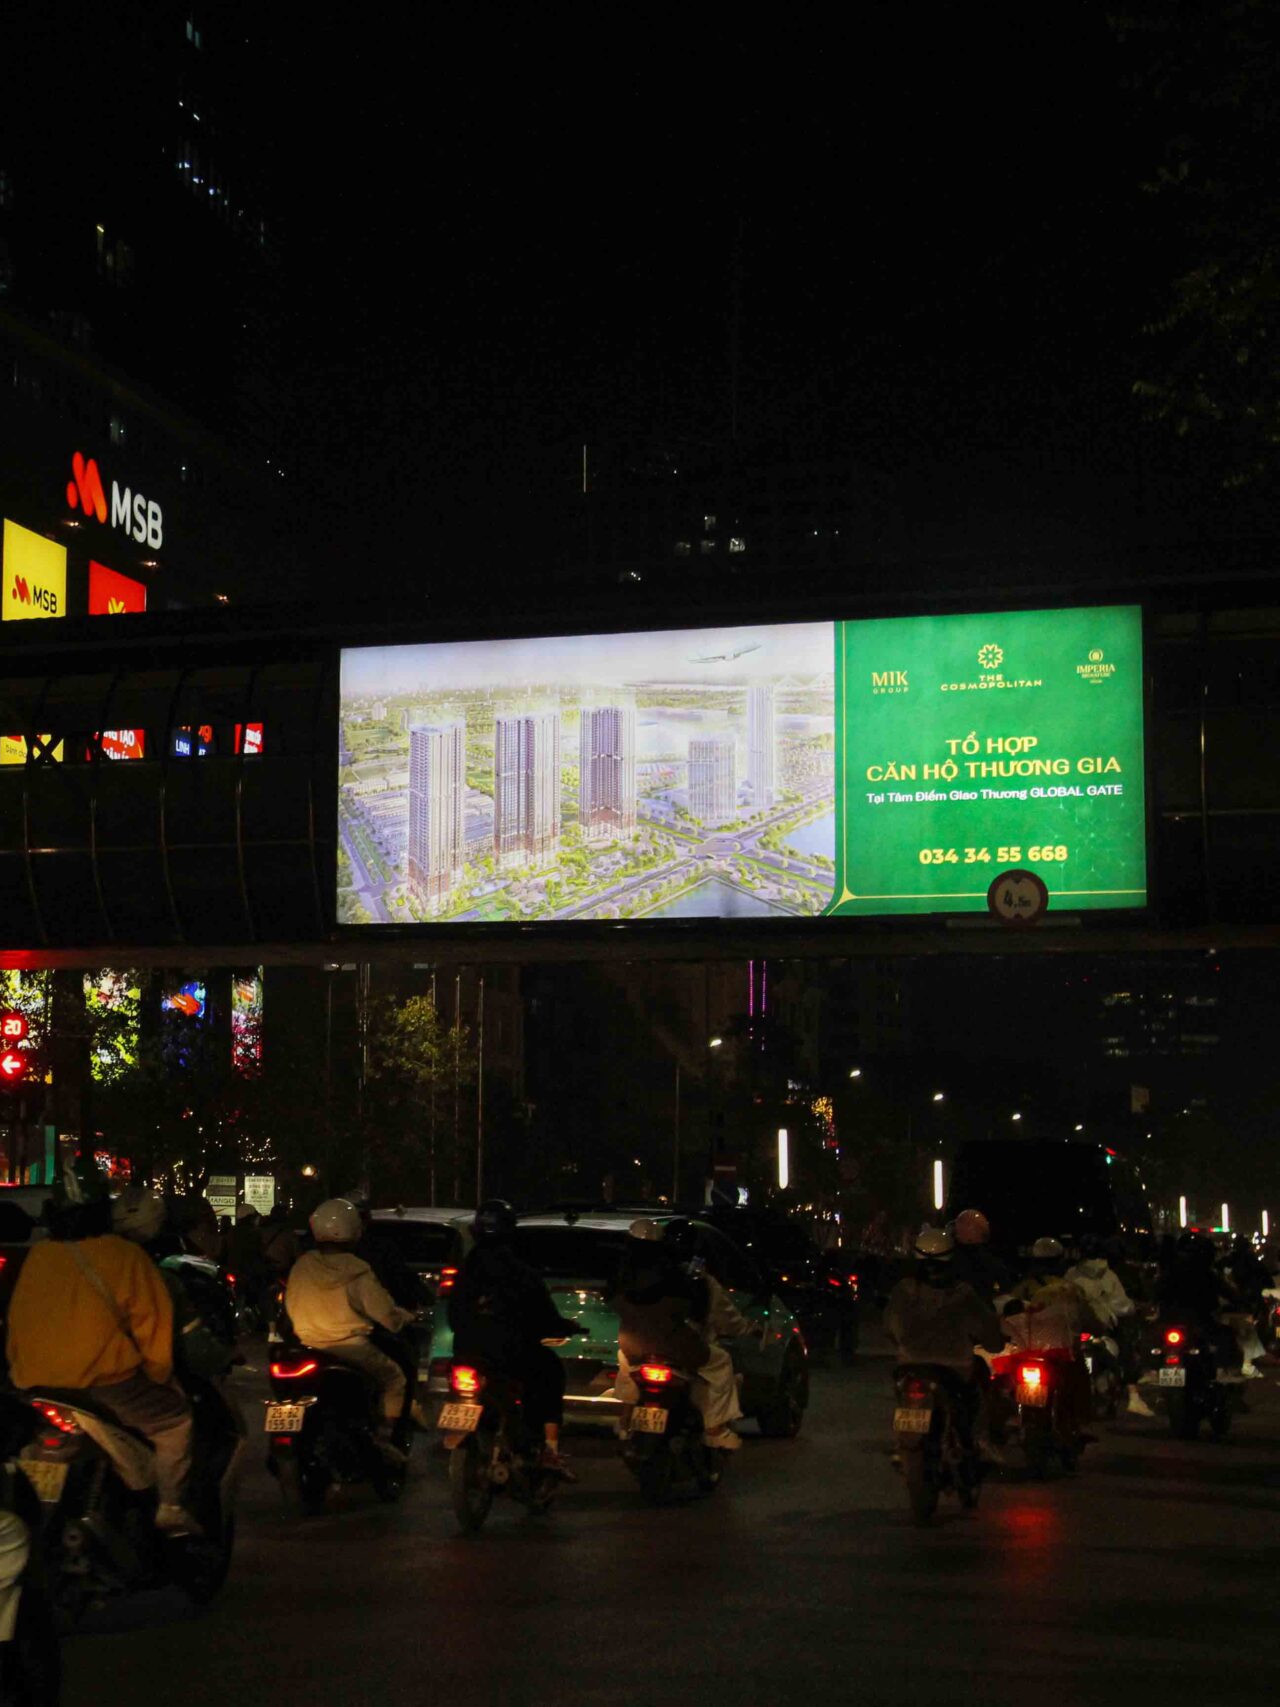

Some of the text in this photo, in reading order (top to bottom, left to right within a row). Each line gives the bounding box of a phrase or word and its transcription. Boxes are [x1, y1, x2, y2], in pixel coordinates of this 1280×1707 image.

[111, 480, 163, 550] MSB
[33, 585, 57, 614] MSB
[871, 670, 909, 686] MIK
[979, 674, 1004, 682] THE
[1076, 662, 1116, 674] IMPERIA
[872, 686, 909, 694] GROUP
[940, 679, 1042, 692] COSMOPOLITAN
[945, 731, 1038, 756] TỔ HỢP
[866, 757, 1122, 782] CĂN HỘ THƯƠNG GIA
[866, 793, 884, 804] Tại
[887, 791, 913, 803] Tâm
[949, 790, 978, 801] Giao
[1029, 786, 1084, 798] GLOBAL
[1086, 784, 1123, 796] GATE
[918, 845, 1069, 865] 034 34 55 668
